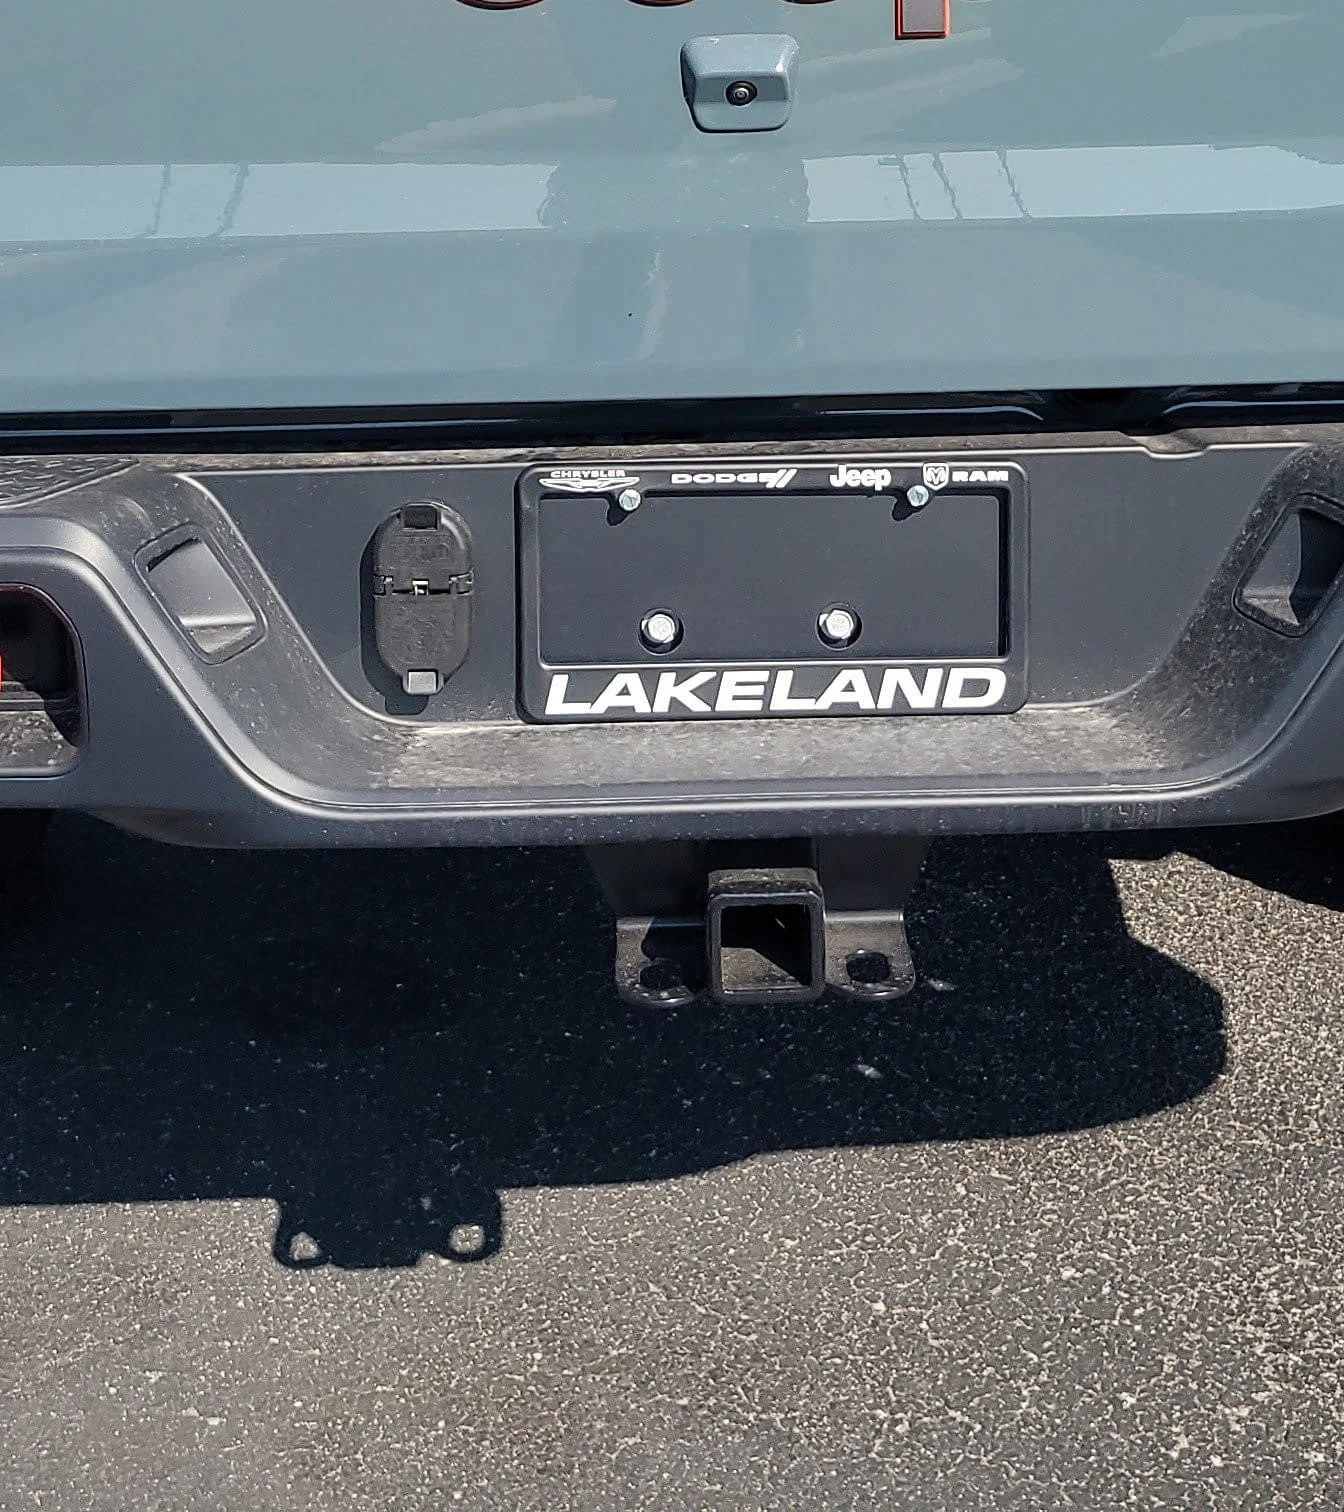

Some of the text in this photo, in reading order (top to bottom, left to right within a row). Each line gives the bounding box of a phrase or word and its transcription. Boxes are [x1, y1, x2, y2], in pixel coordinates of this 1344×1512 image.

[550, 464, 1009, 491] CHRYSLER DODGE Jeep RAM
[544, 667, 1007, 716] LAKELAND
